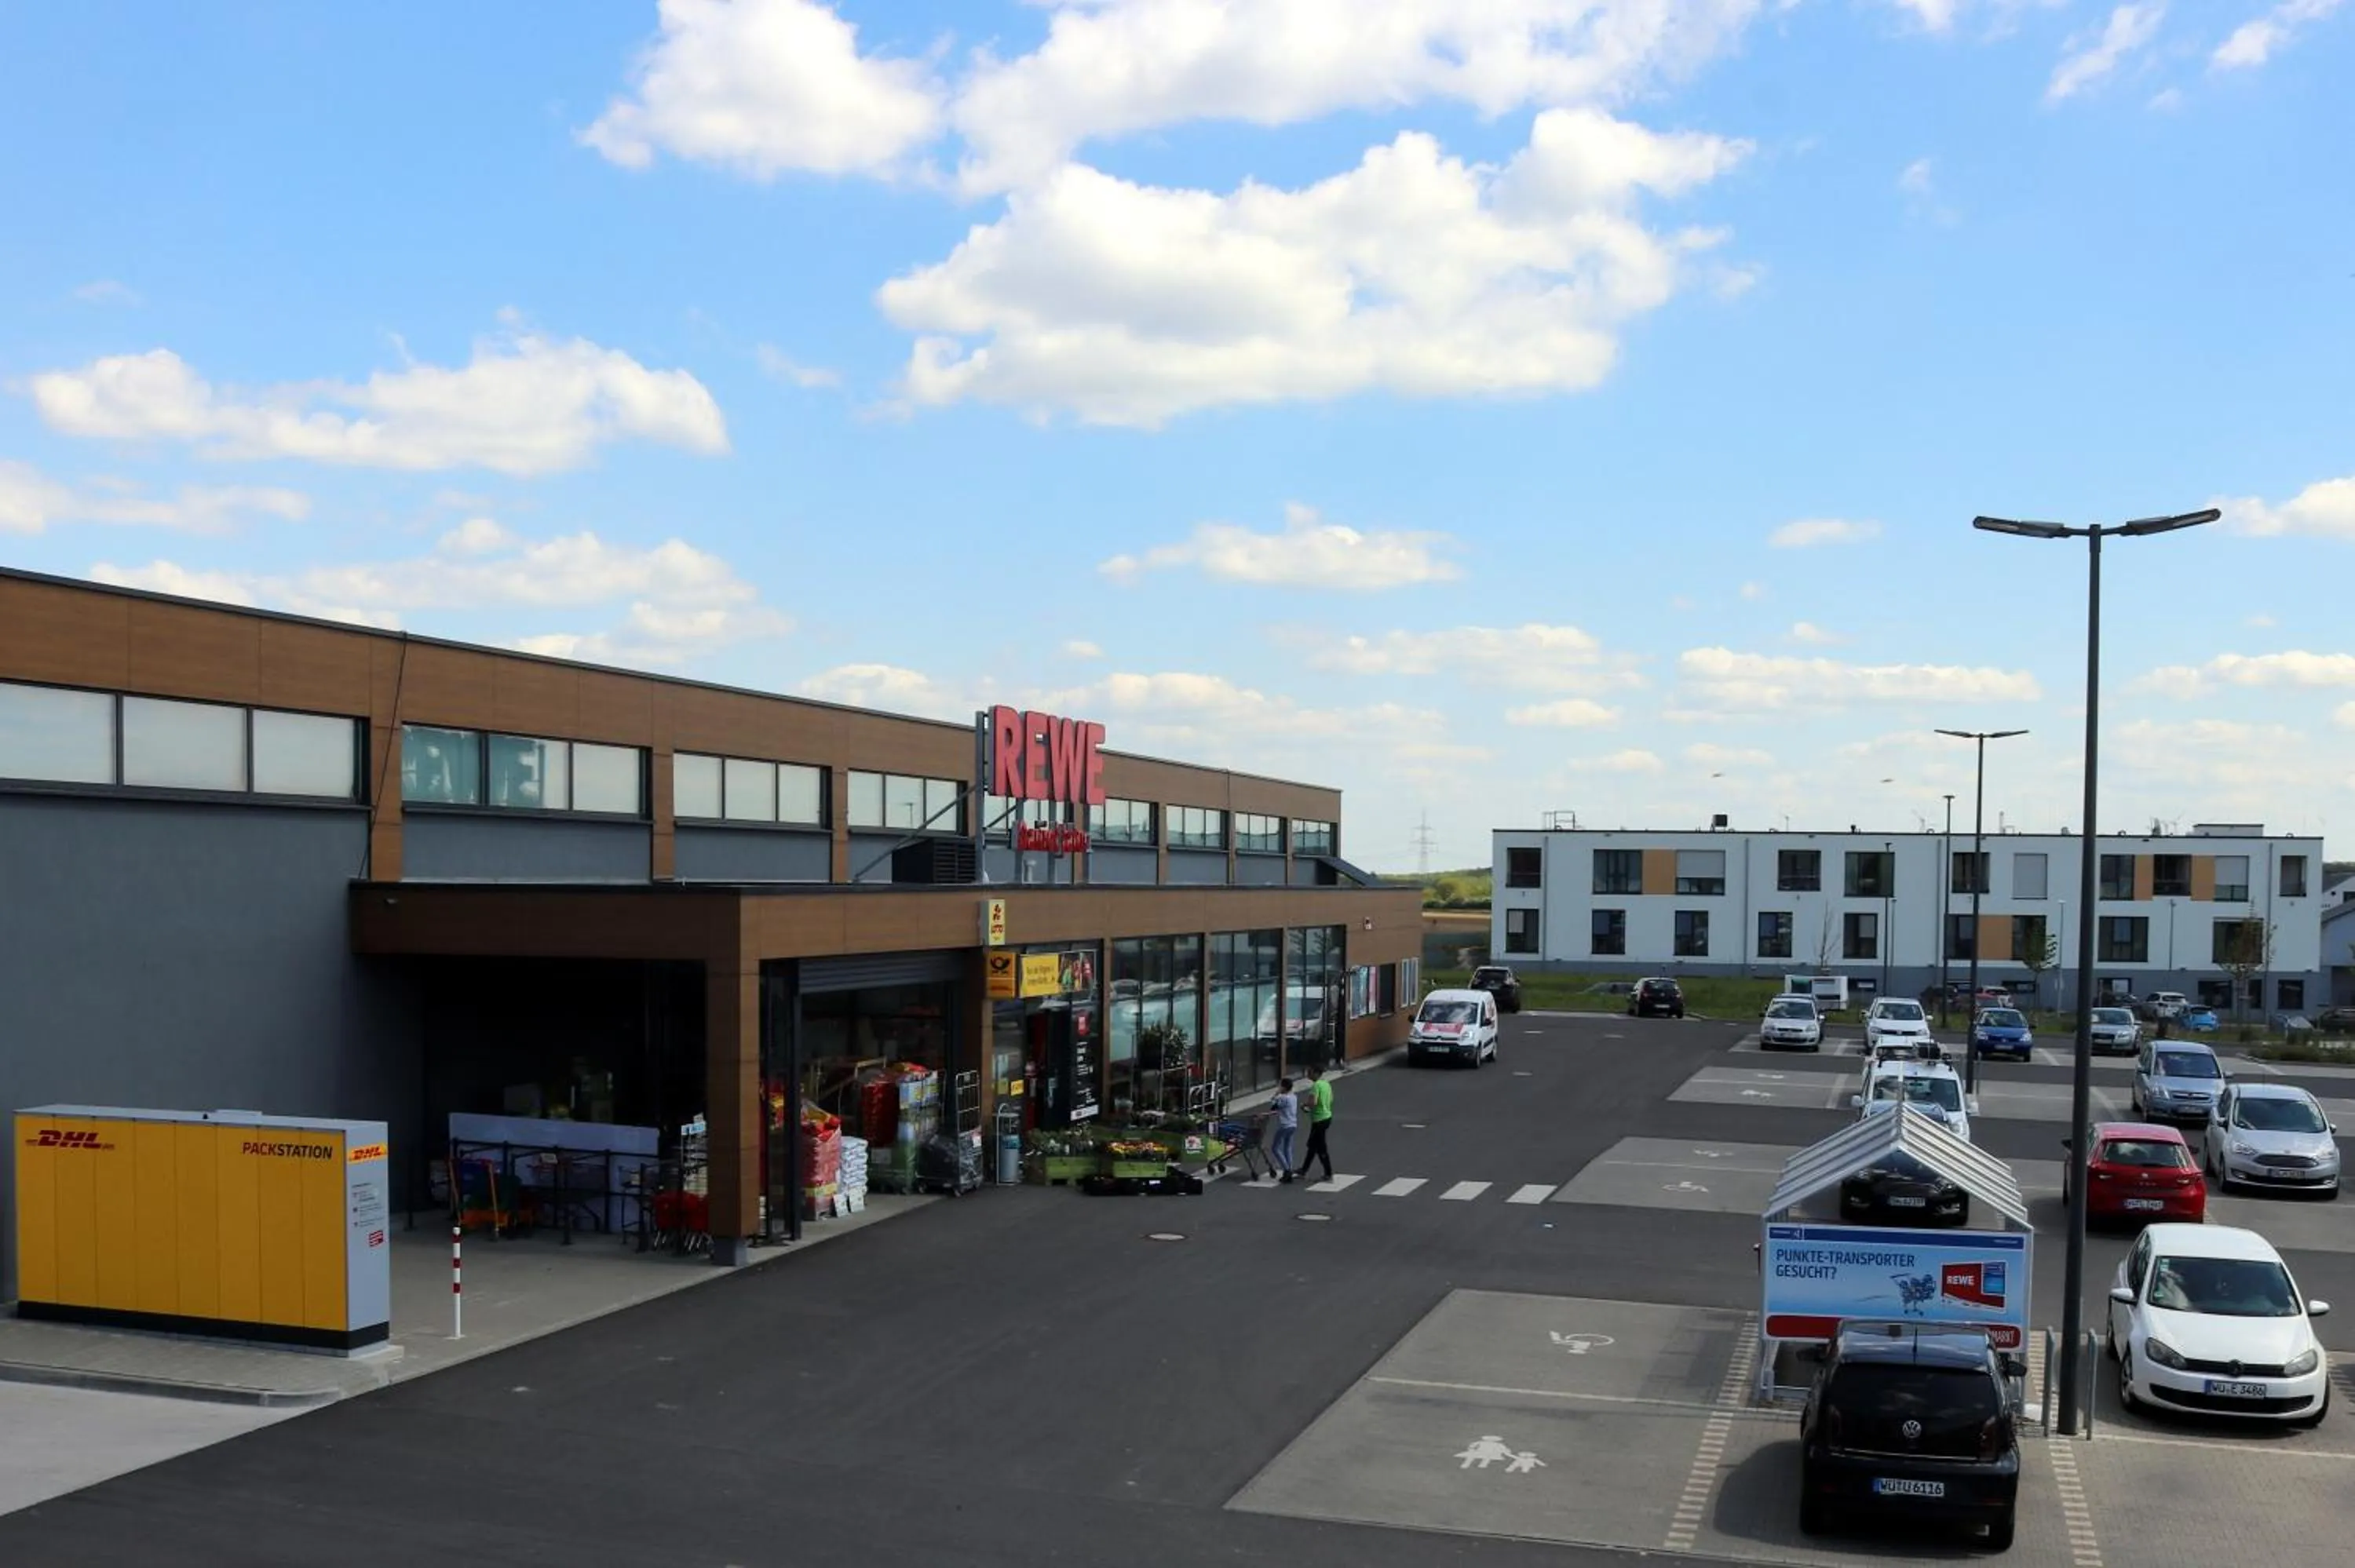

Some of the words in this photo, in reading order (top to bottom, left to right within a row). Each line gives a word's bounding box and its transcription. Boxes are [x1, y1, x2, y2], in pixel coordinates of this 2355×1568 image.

[991, 704, 1106, 804] REWE
[38, 1129, 101, 1149] DHL
[242, 1142, 333, 1159] PACKSTATION
[1776, 1249, 1915, 1267] PUNKTE-TRANSPORTER
[1776, 1265, 1837, 1280] GESUCHT?
[1946, 1274, 1975, 1286] REWE
[1914, 1482, 1942, 1495] 6116
